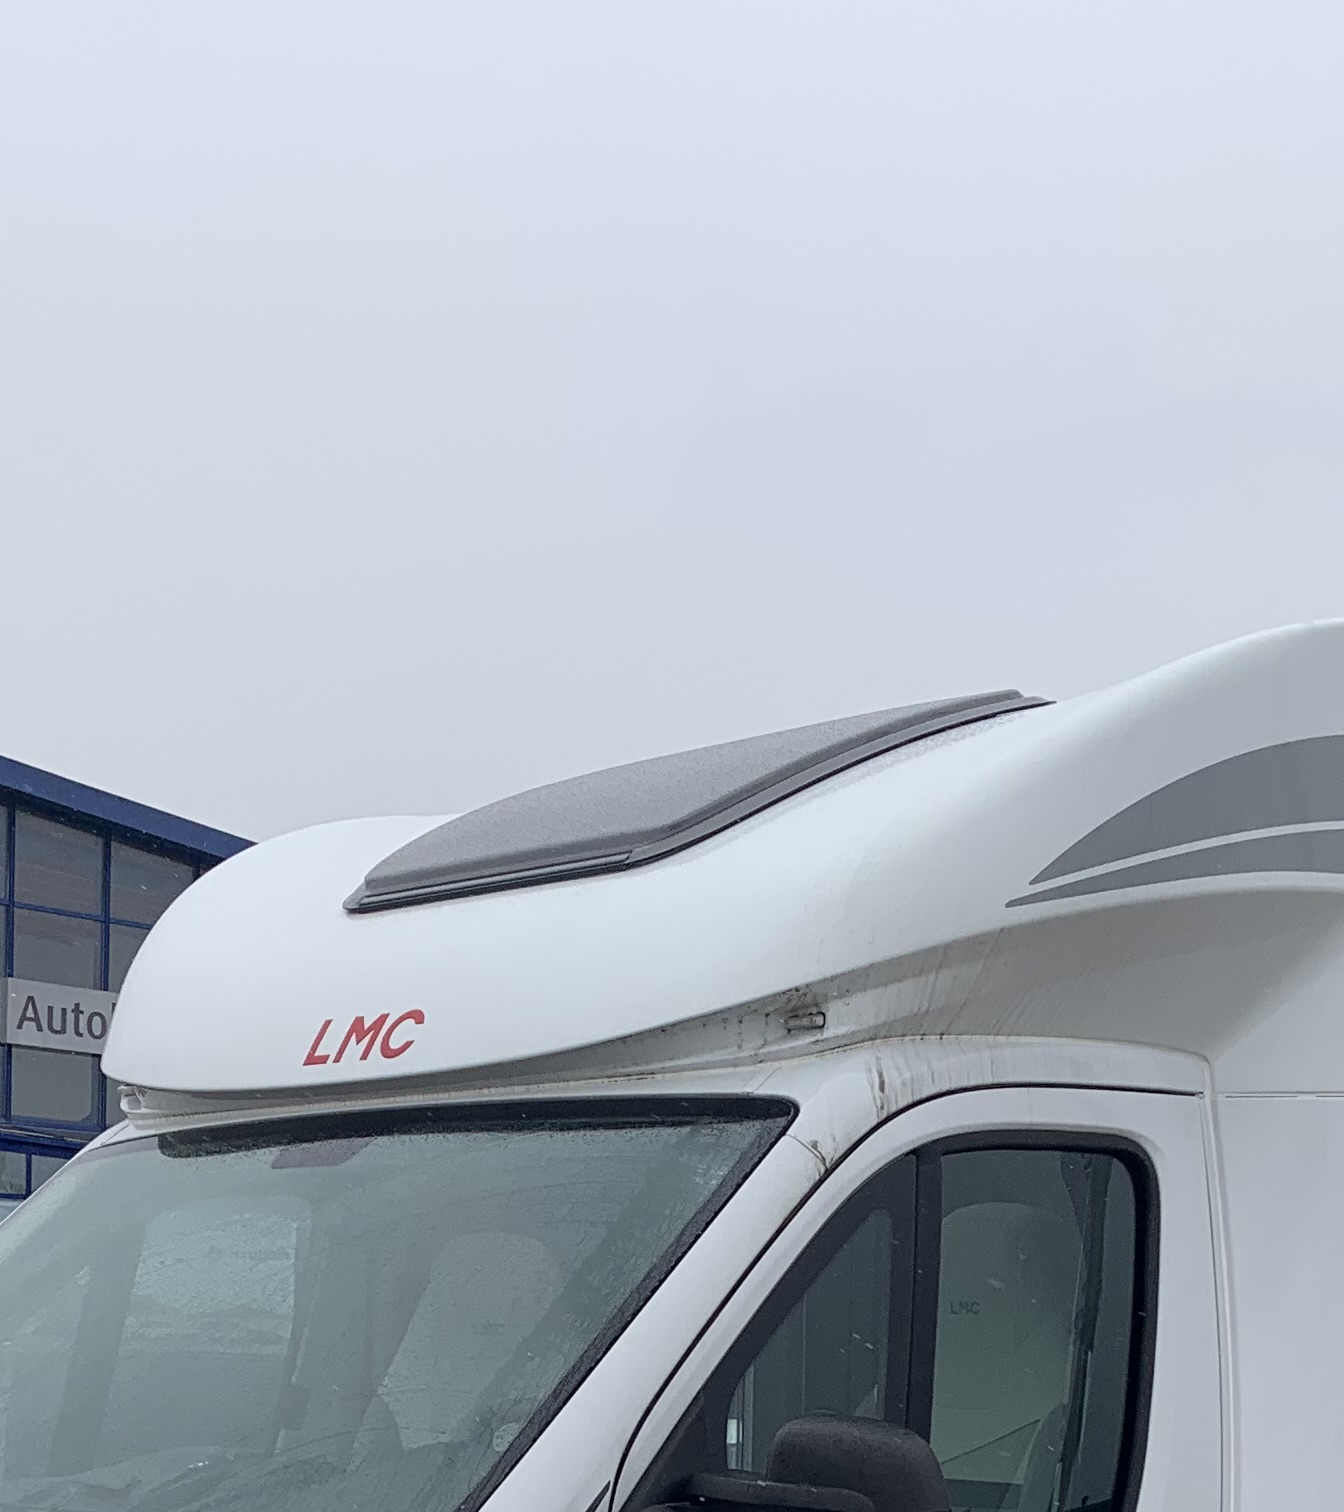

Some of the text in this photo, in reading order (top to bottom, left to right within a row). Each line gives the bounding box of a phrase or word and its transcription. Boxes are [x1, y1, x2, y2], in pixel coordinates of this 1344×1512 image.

[16, 995, 117, 1040] Auto
[302, 1008, 425, 1066] LMC
[949, 1300, 980, 1315] LMC
